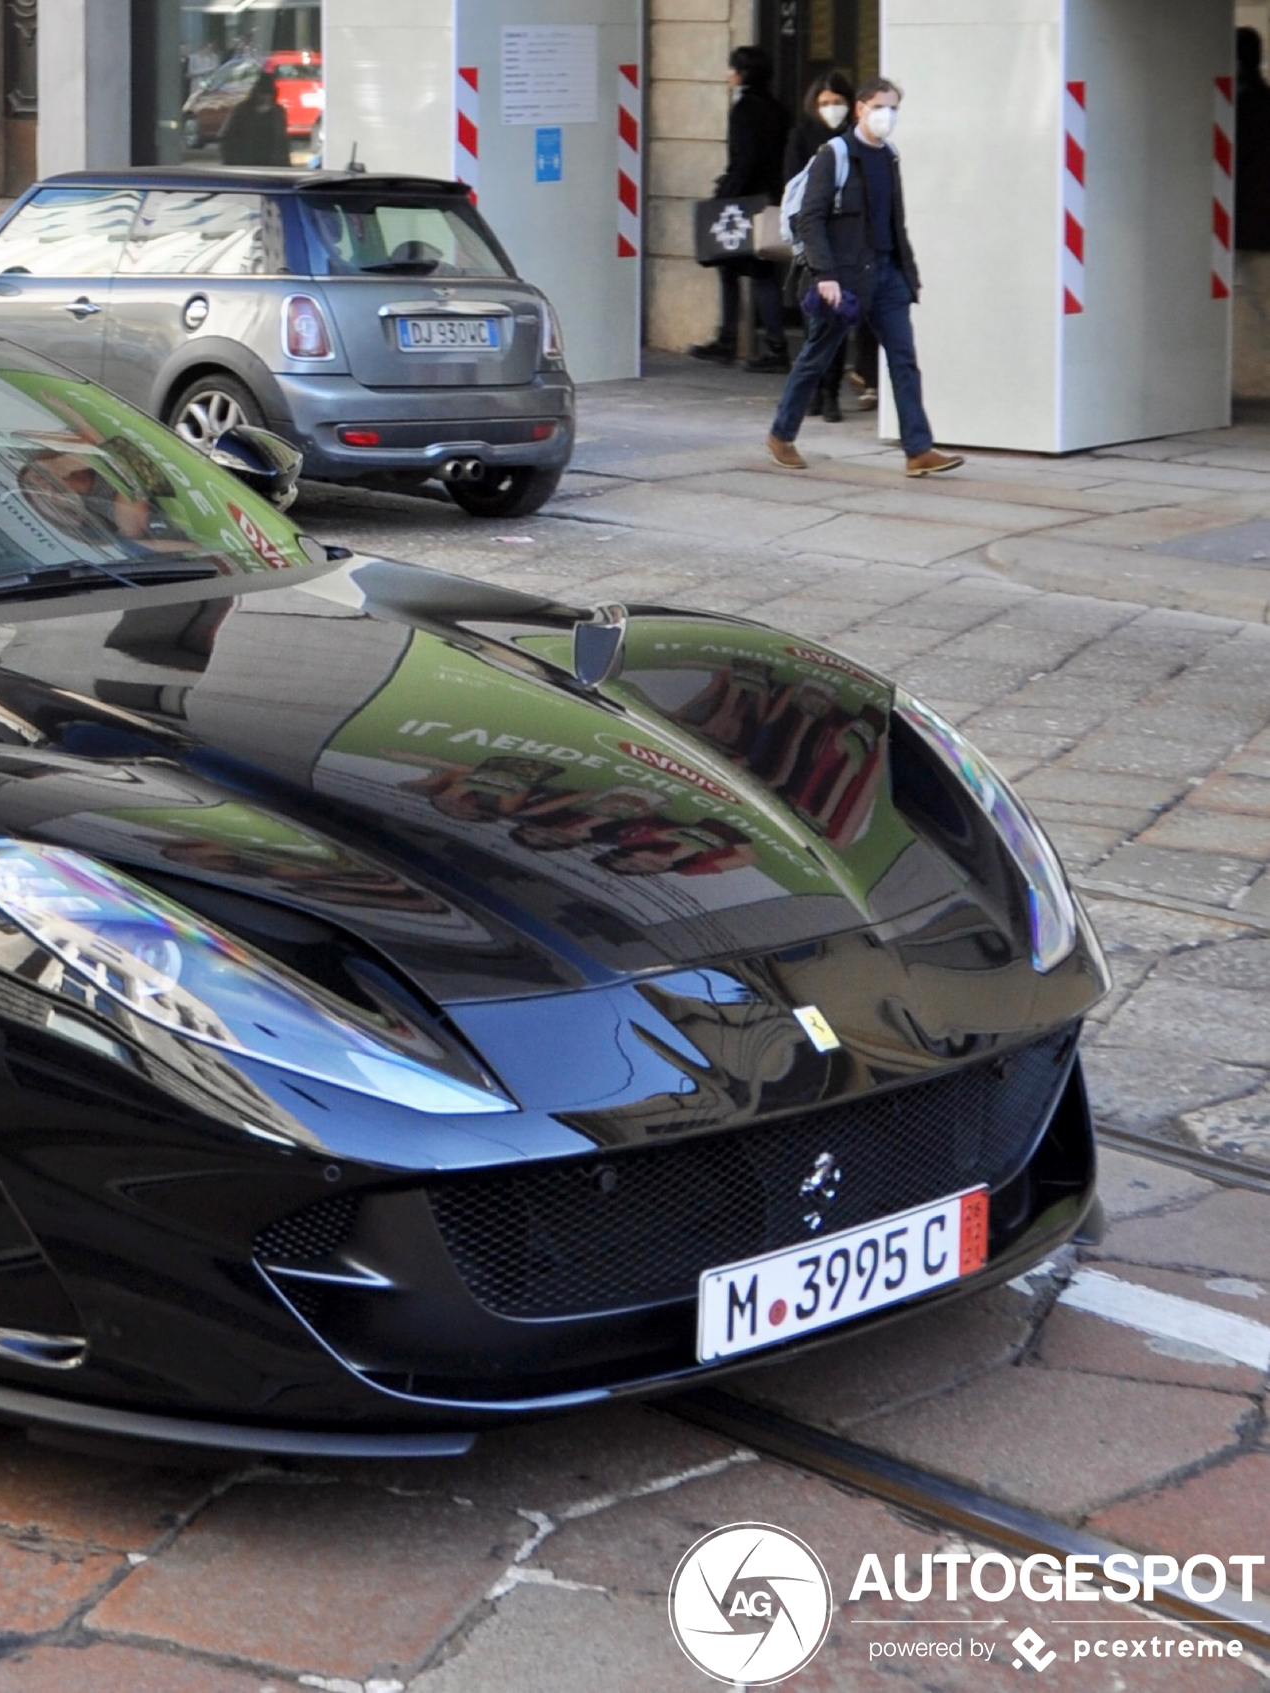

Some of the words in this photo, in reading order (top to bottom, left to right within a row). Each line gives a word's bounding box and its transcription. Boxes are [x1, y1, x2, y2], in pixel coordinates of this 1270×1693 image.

[411, 322, 432, 343] DJ
[726, 1273, 758, 1343] M
[795, 1226, 909, 1321] 3995
[923, 1214, 948, 1276] C
